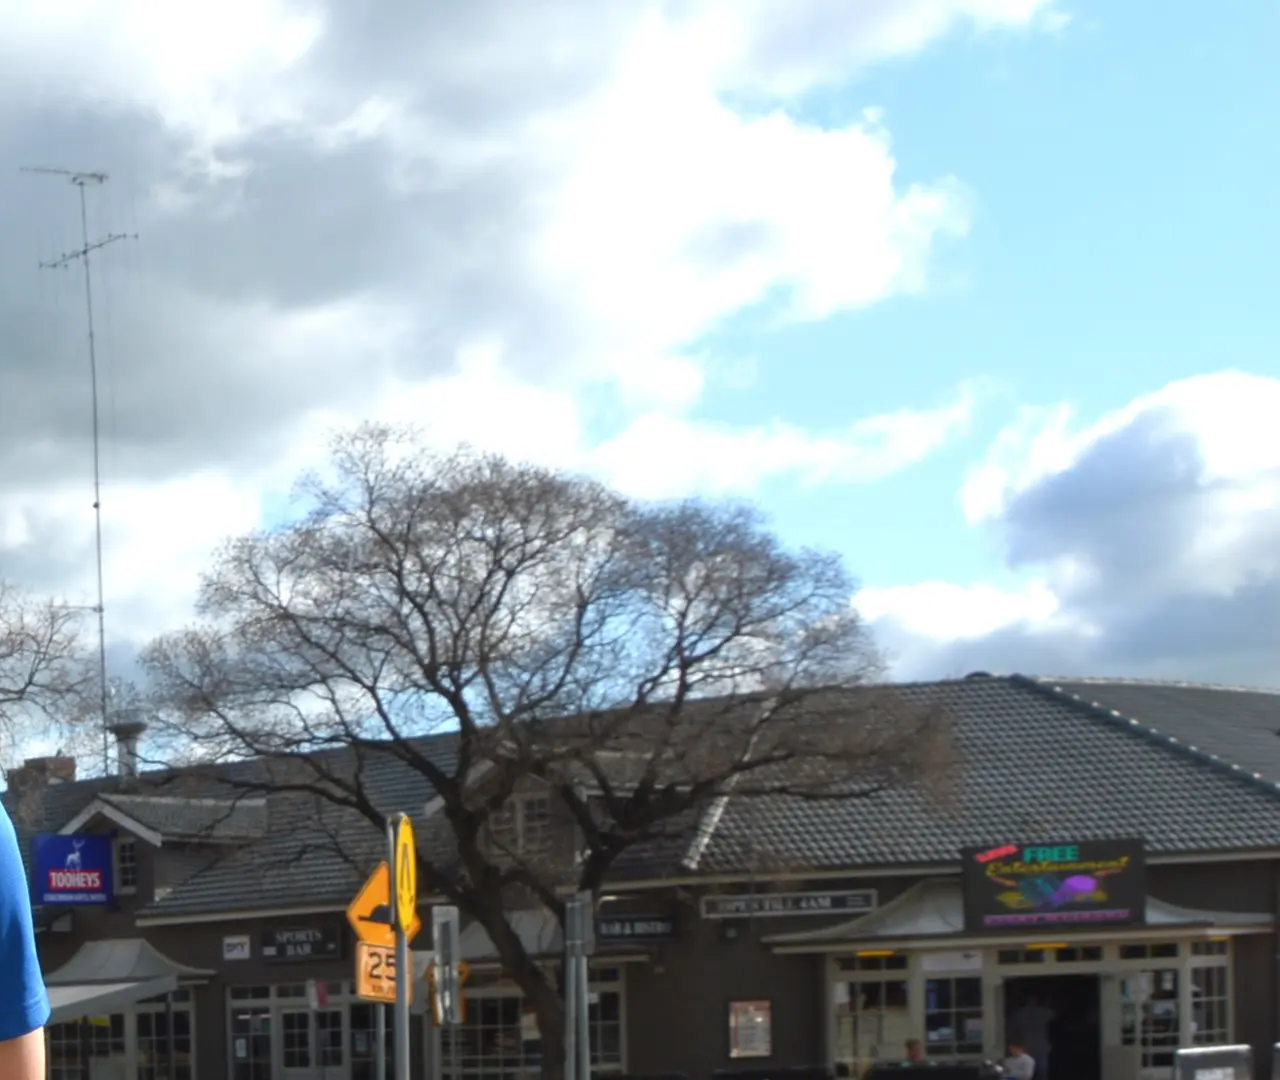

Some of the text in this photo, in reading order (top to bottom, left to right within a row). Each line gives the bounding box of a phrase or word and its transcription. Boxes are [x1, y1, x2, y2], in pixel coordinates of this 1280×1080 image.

[1023, 845, 1079, 863] FREE
[49, 872, 101, 888] TOOHEYS
[276, 929, 322, 943] SPORTS
[286, 943, 313, 956] BAR
[368, 952, 397, 981] 25
